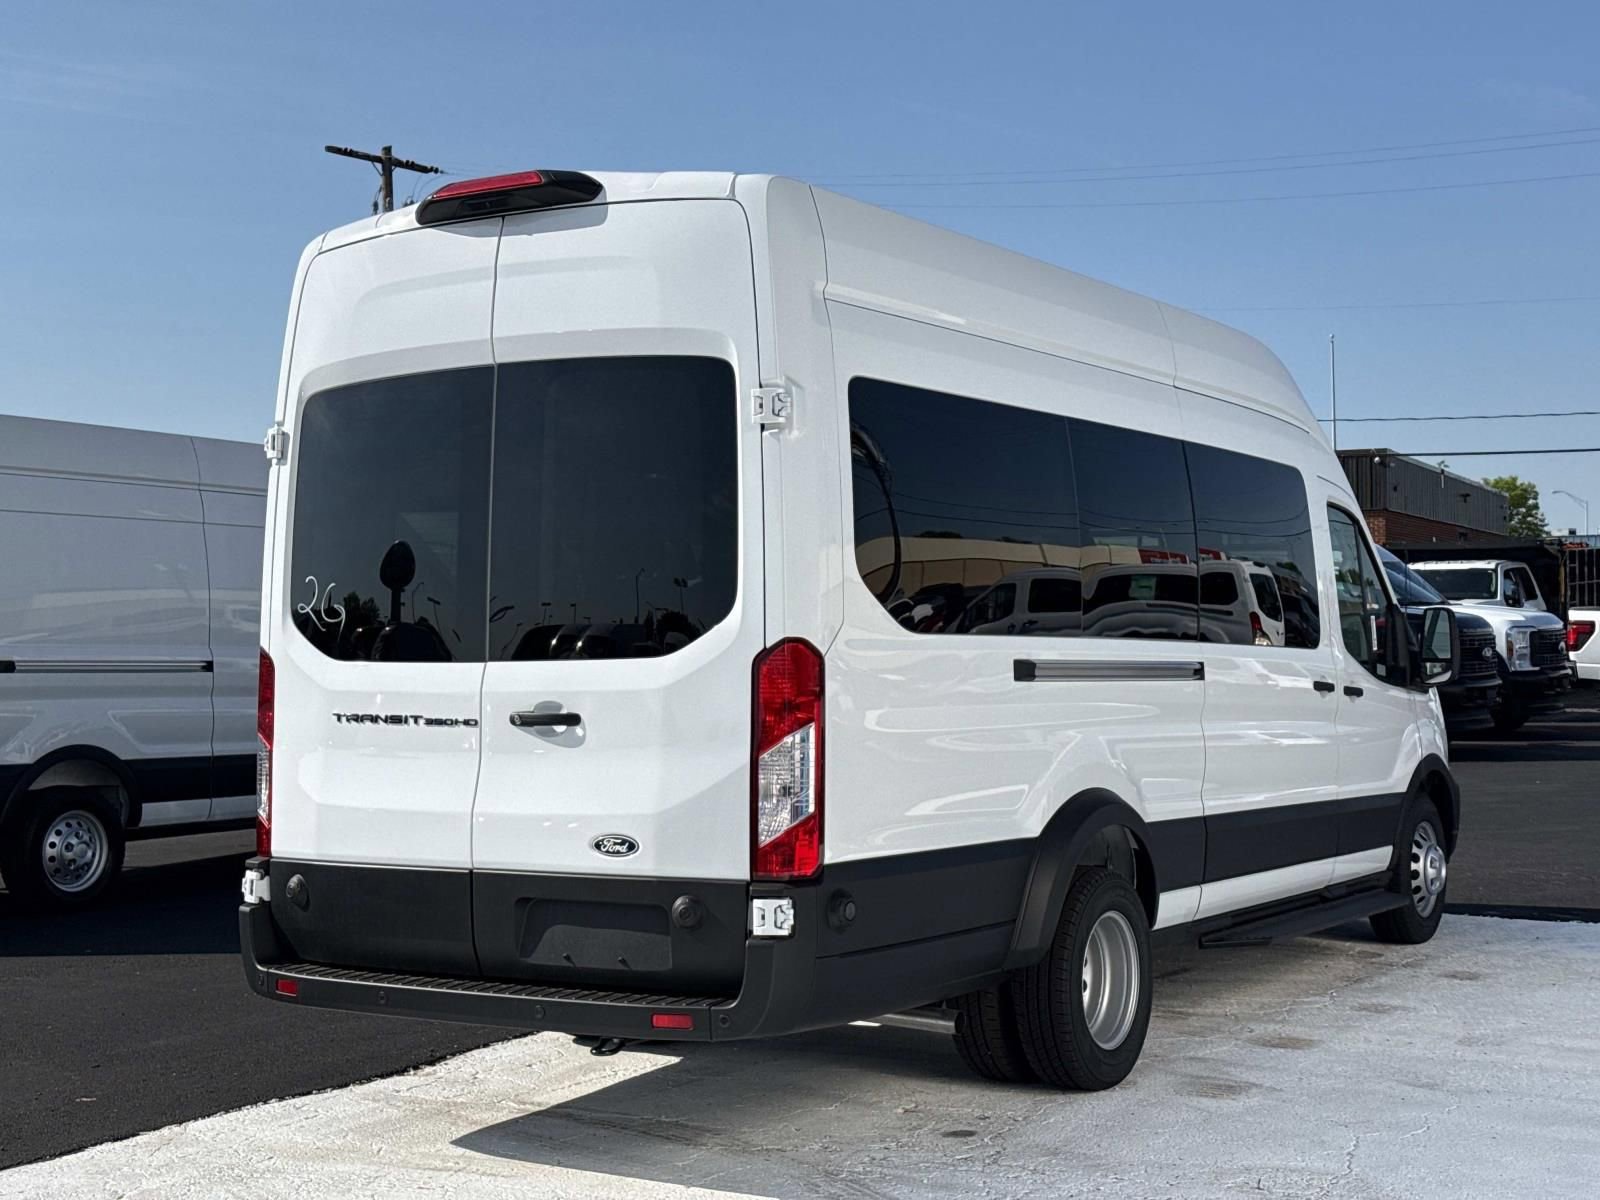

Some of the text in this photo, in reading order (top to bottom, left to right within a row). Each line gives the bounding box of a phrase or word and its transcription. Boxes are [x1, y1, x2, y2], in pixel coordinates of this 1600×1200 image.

[332, 712, 479, 728] TRANSIT 350HD
[599, 838, 629, 853] Ford
